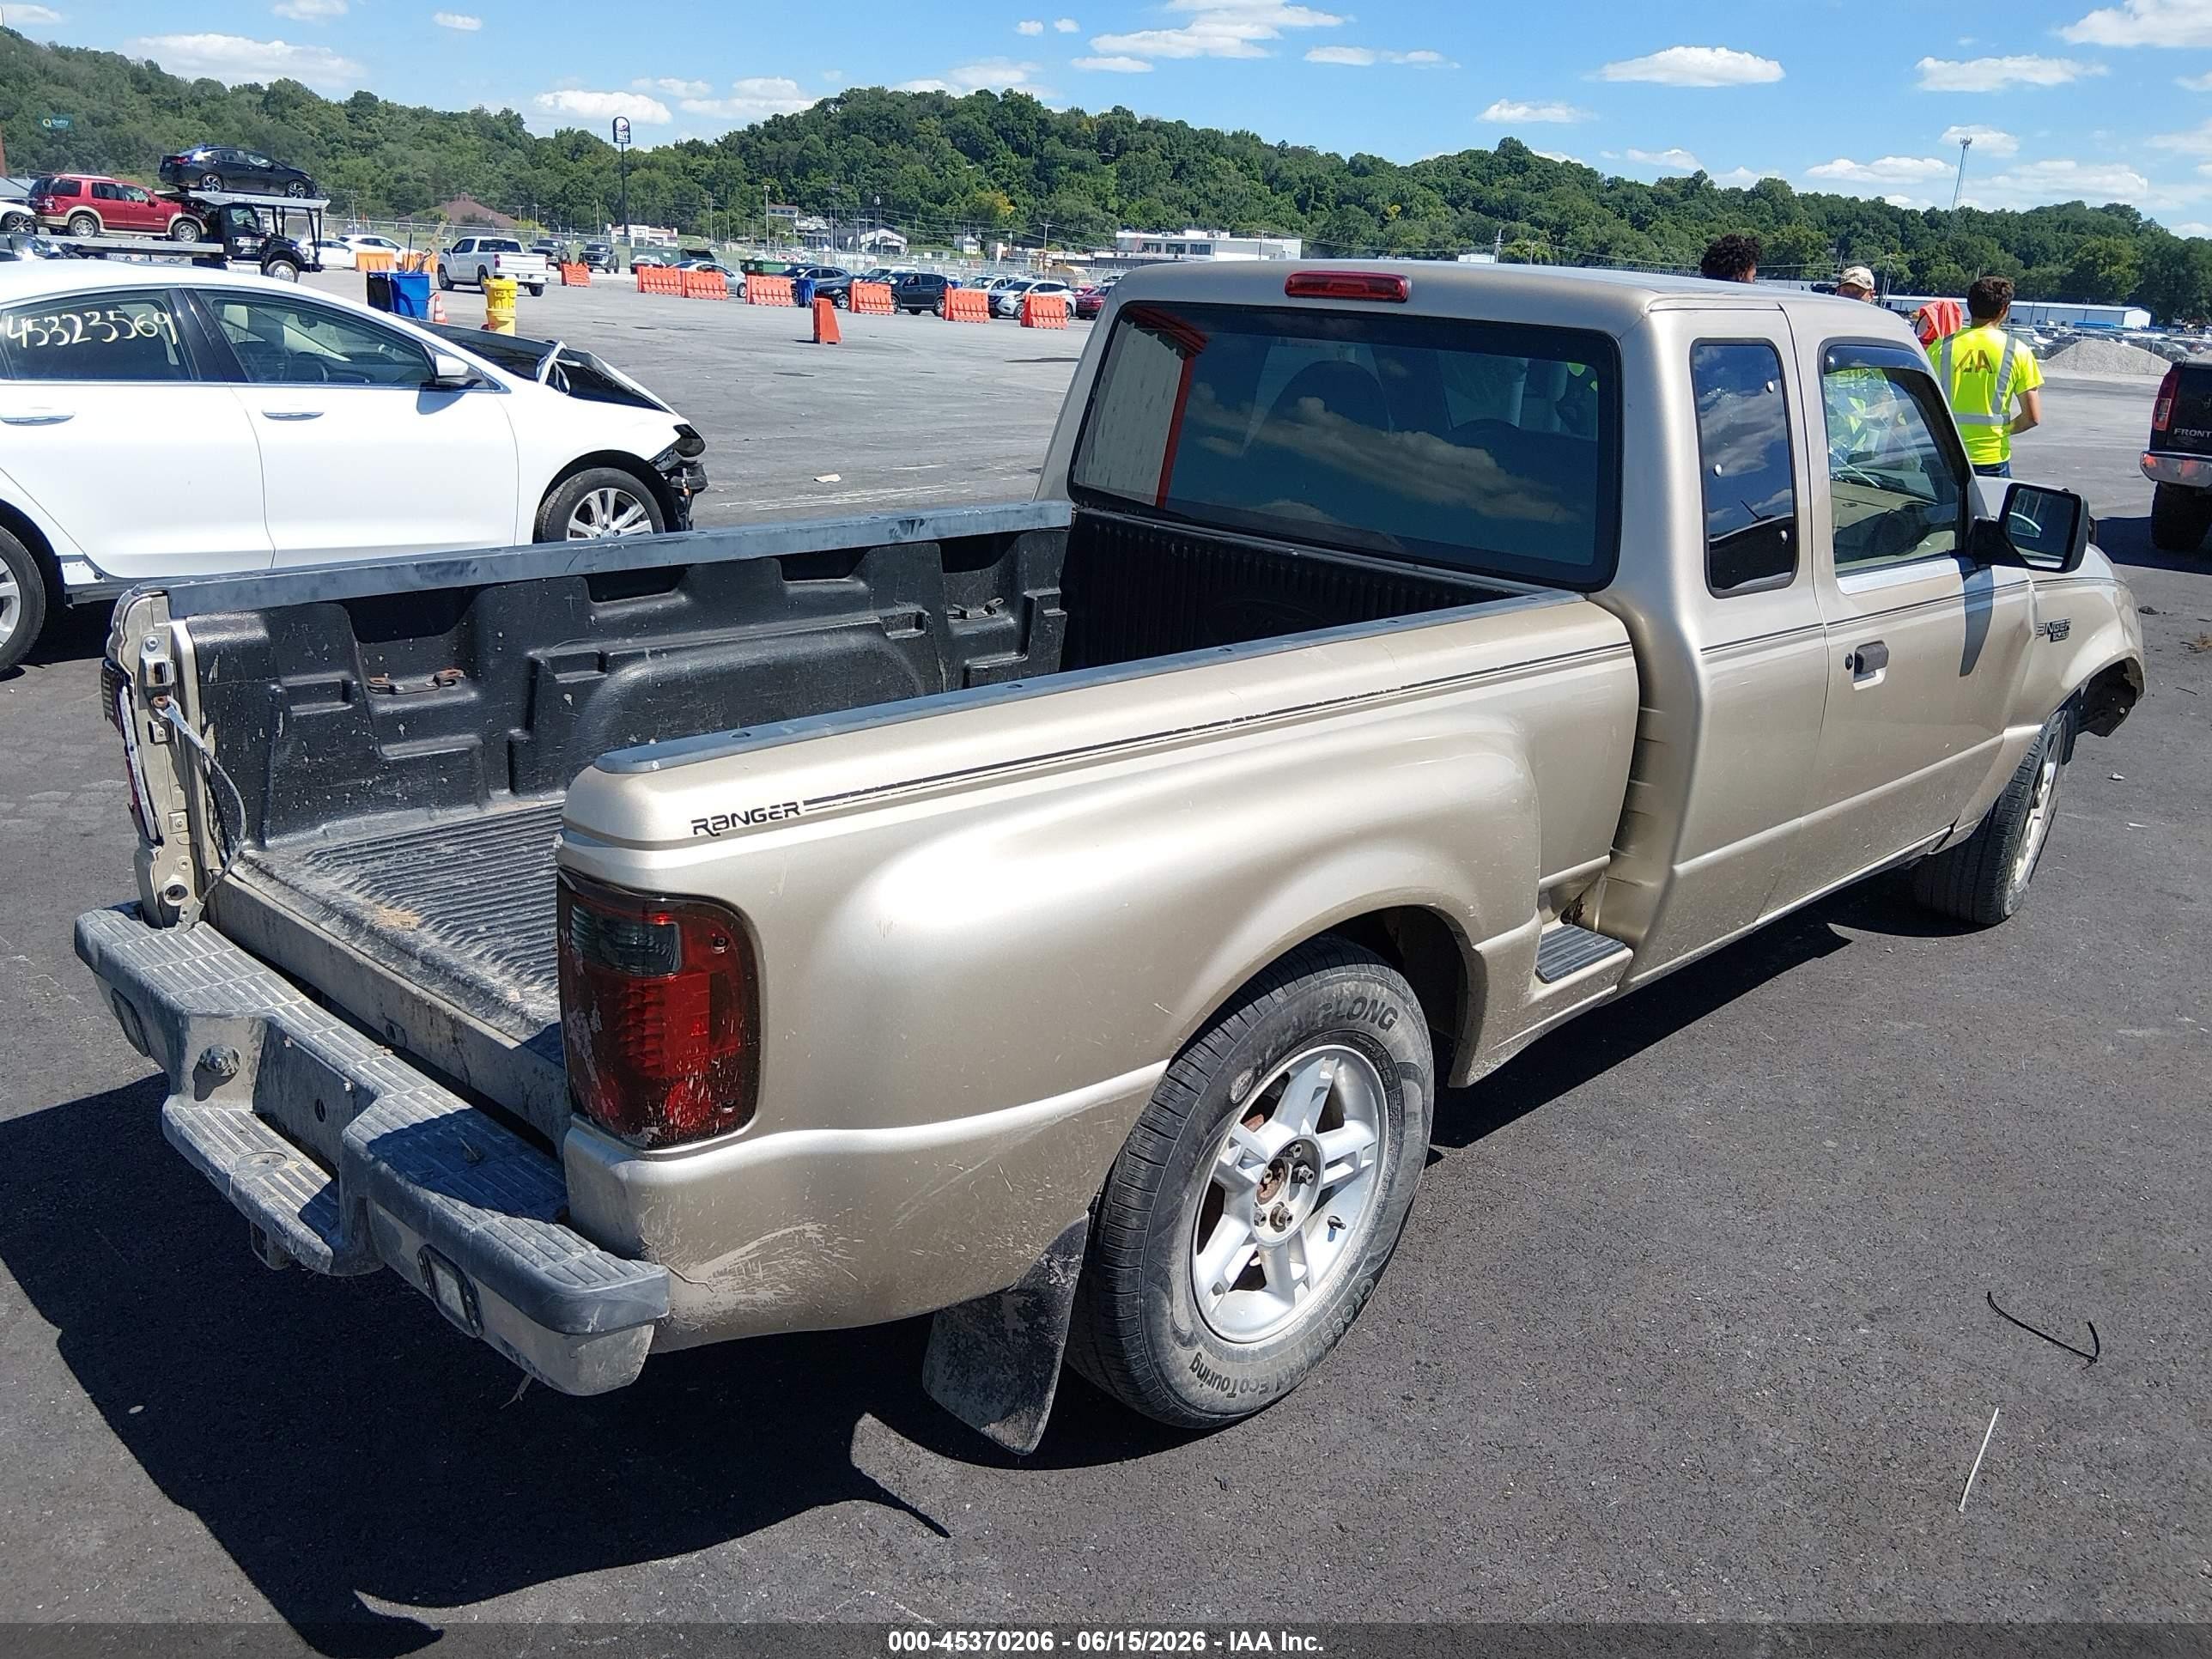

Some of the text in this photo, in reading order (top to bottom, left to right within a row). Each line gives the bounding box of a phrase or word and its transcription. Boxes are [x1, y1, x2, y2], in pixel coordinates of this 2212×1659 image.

[7, 310, 178, 349] 45323569
[2173, 428, 2212, 439] FRONT
[690, 801, 801, 836] RANGER
